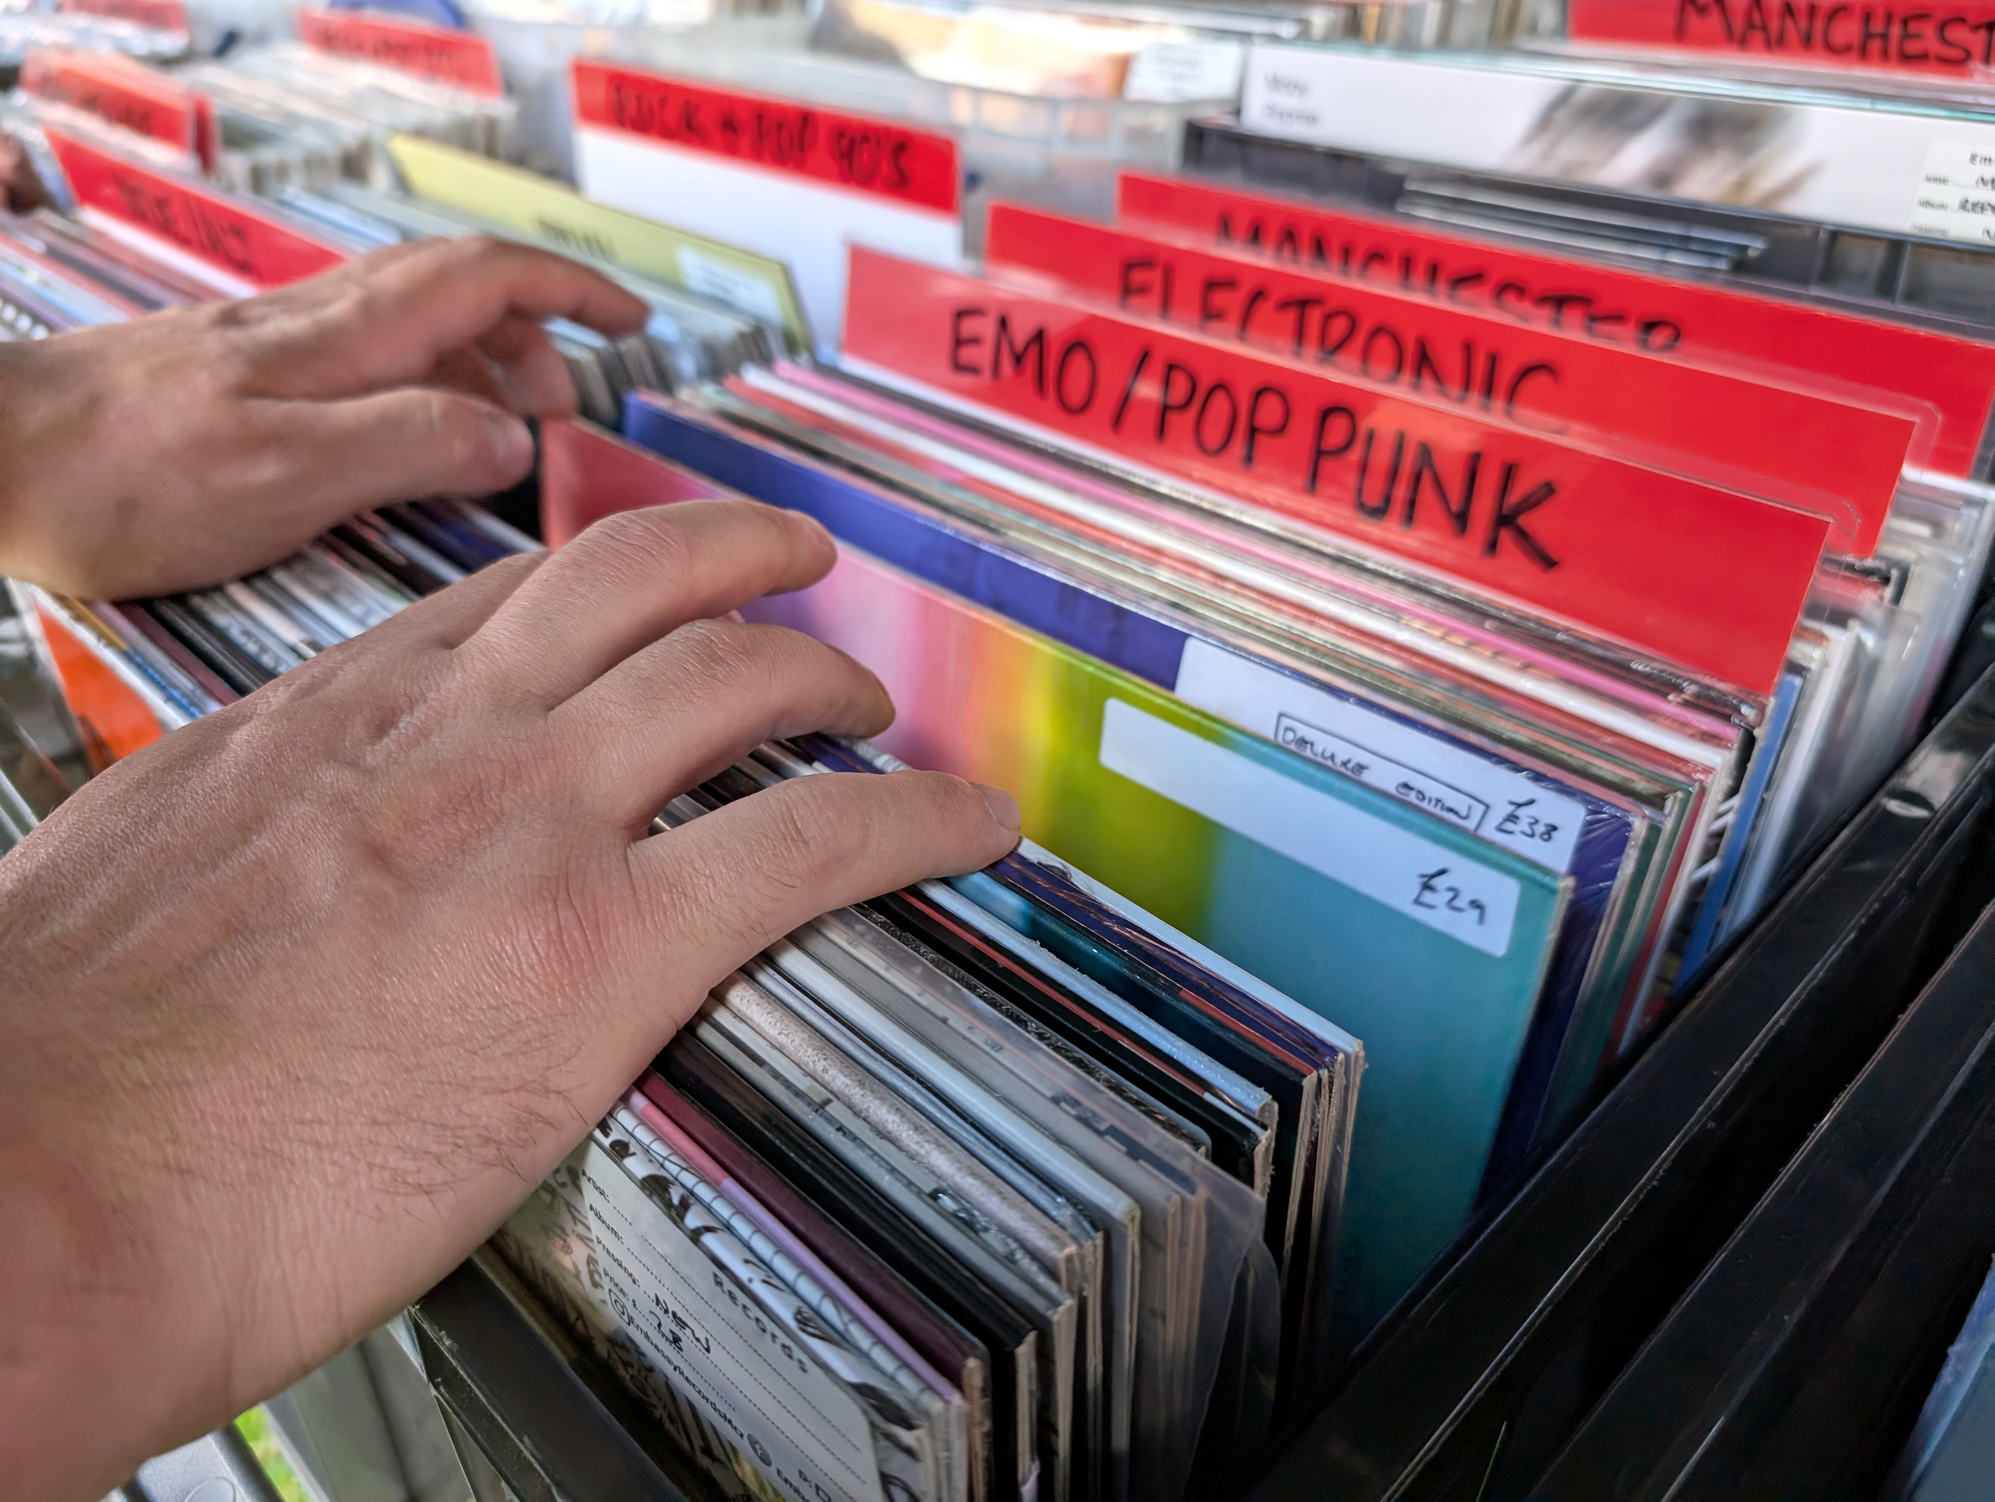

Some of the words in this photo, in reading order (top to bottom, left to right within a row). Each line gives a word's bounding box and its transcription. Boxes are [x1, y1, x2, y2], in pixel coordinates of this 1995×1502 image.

[1673, 0, 1995, 66] MANCHEST
[951, 308, 1097, 415] EMO
[1308, 405, 1560, 572] PUNK
[1494, 798, 1559, 843] £38
[1411, 867, 1487, 927] £29
[588, 1203, 625, 1246] Album:
[595, 1234, 641, 1288] Pressing:
[654, 1292, 712, 1354] NEW
[712, 1271, 808, 1374] Records
